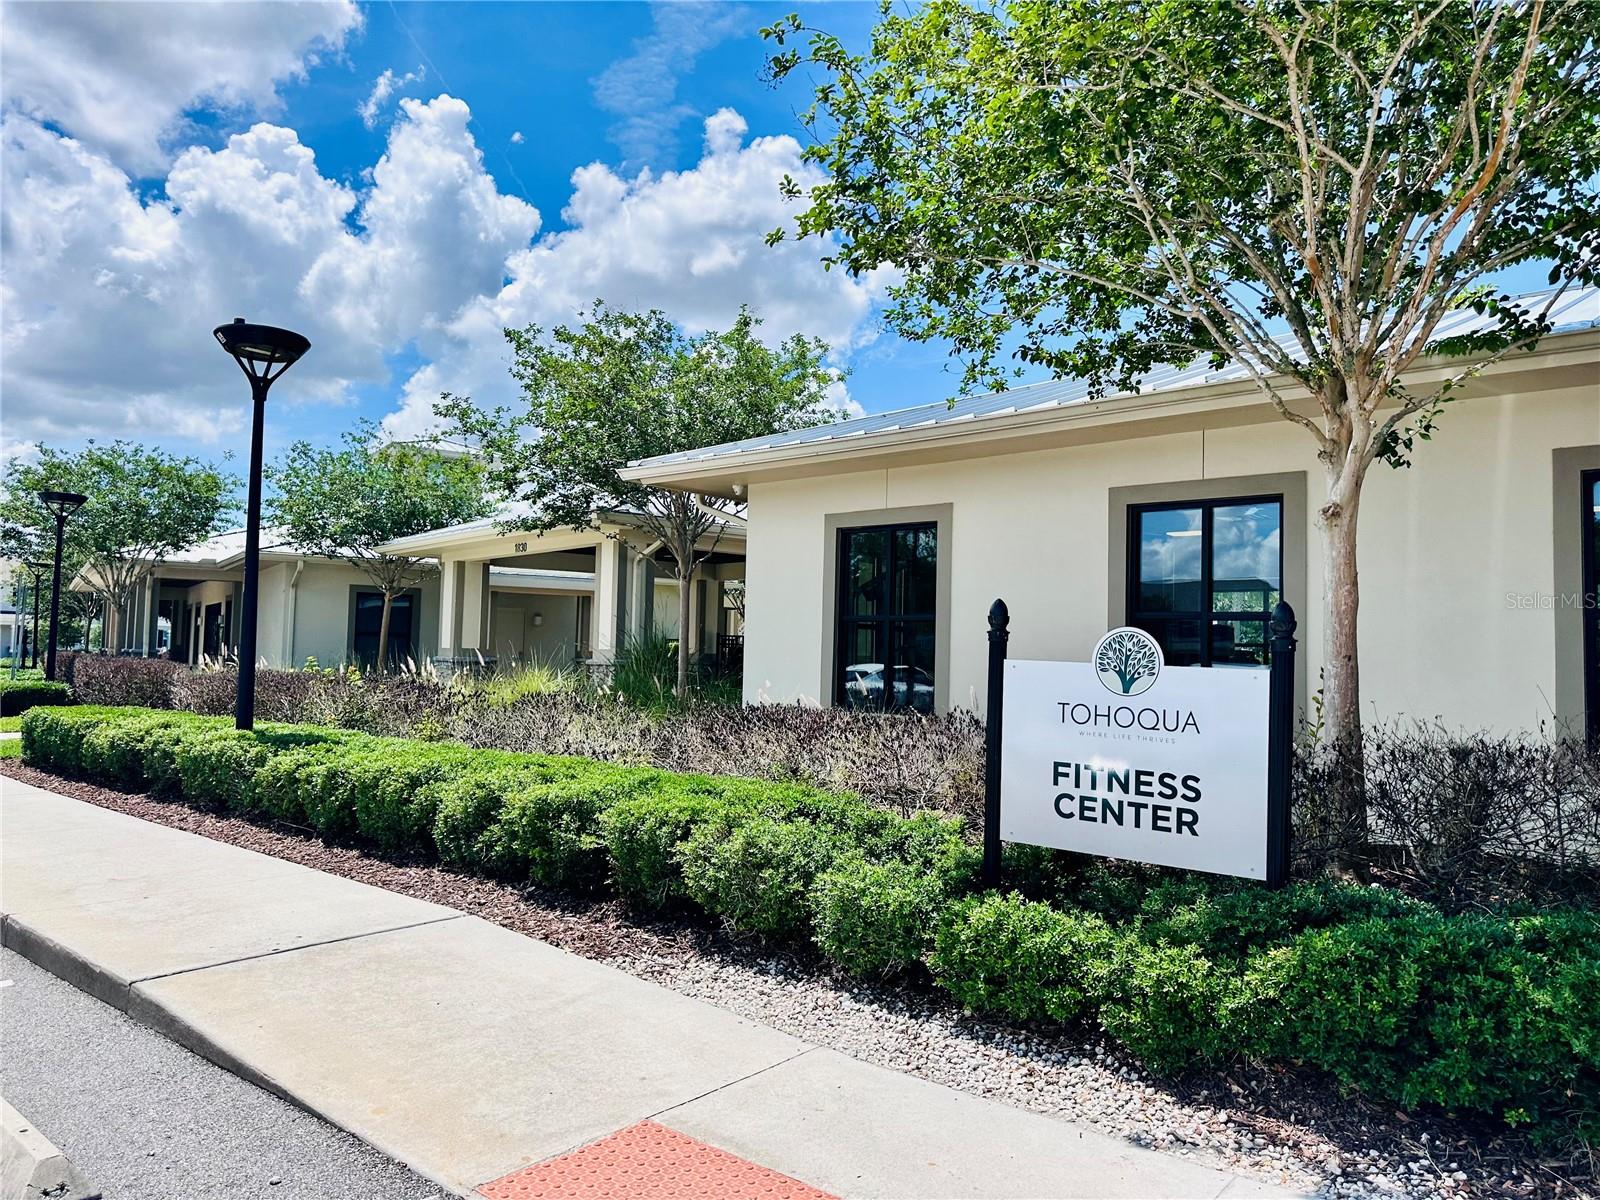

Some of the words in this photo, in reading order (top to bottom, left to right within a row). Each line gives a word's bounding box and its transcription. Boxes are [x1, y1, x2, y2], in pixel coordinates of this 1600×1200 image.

[1057, 702, 1201, 735] TOHOQUA
[1079, 730, 1108, 739] WHERE
[1112, 733, 1132, 741] LIFE
[1137, 735, 1177, 745] THRIVES
[1052, 760, 1202, 803] FITNESS
[1053, 792, 1200, 837] CENTER
